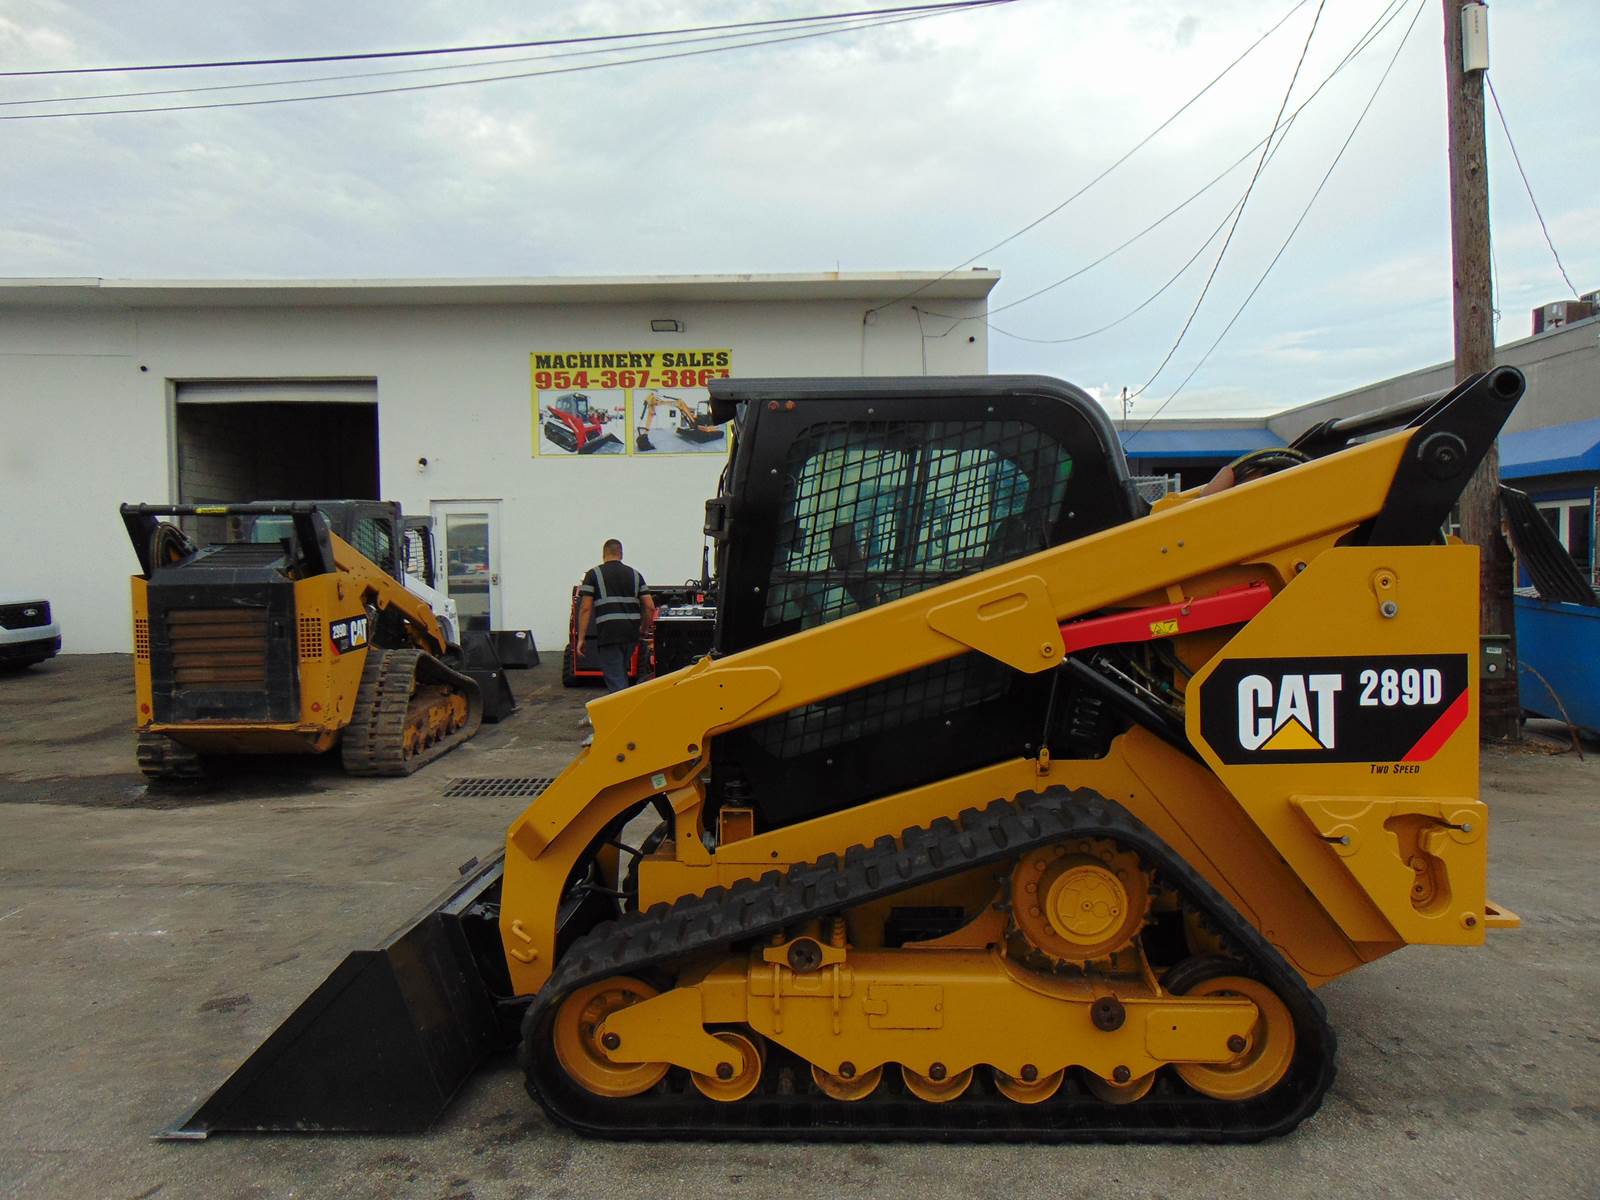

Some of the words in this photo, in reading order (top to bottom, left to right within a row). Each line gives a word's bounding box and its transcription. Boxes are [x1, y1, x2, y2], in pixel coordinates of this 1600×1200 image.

[535, 352, 655, 369] MACHINERY
[662, 351, 729, 368] SALES
[350, 618, 368, 647] CAT
[1237, 673, 1343, 751] CAT
[1359, 668, 1443, 706] 289D
